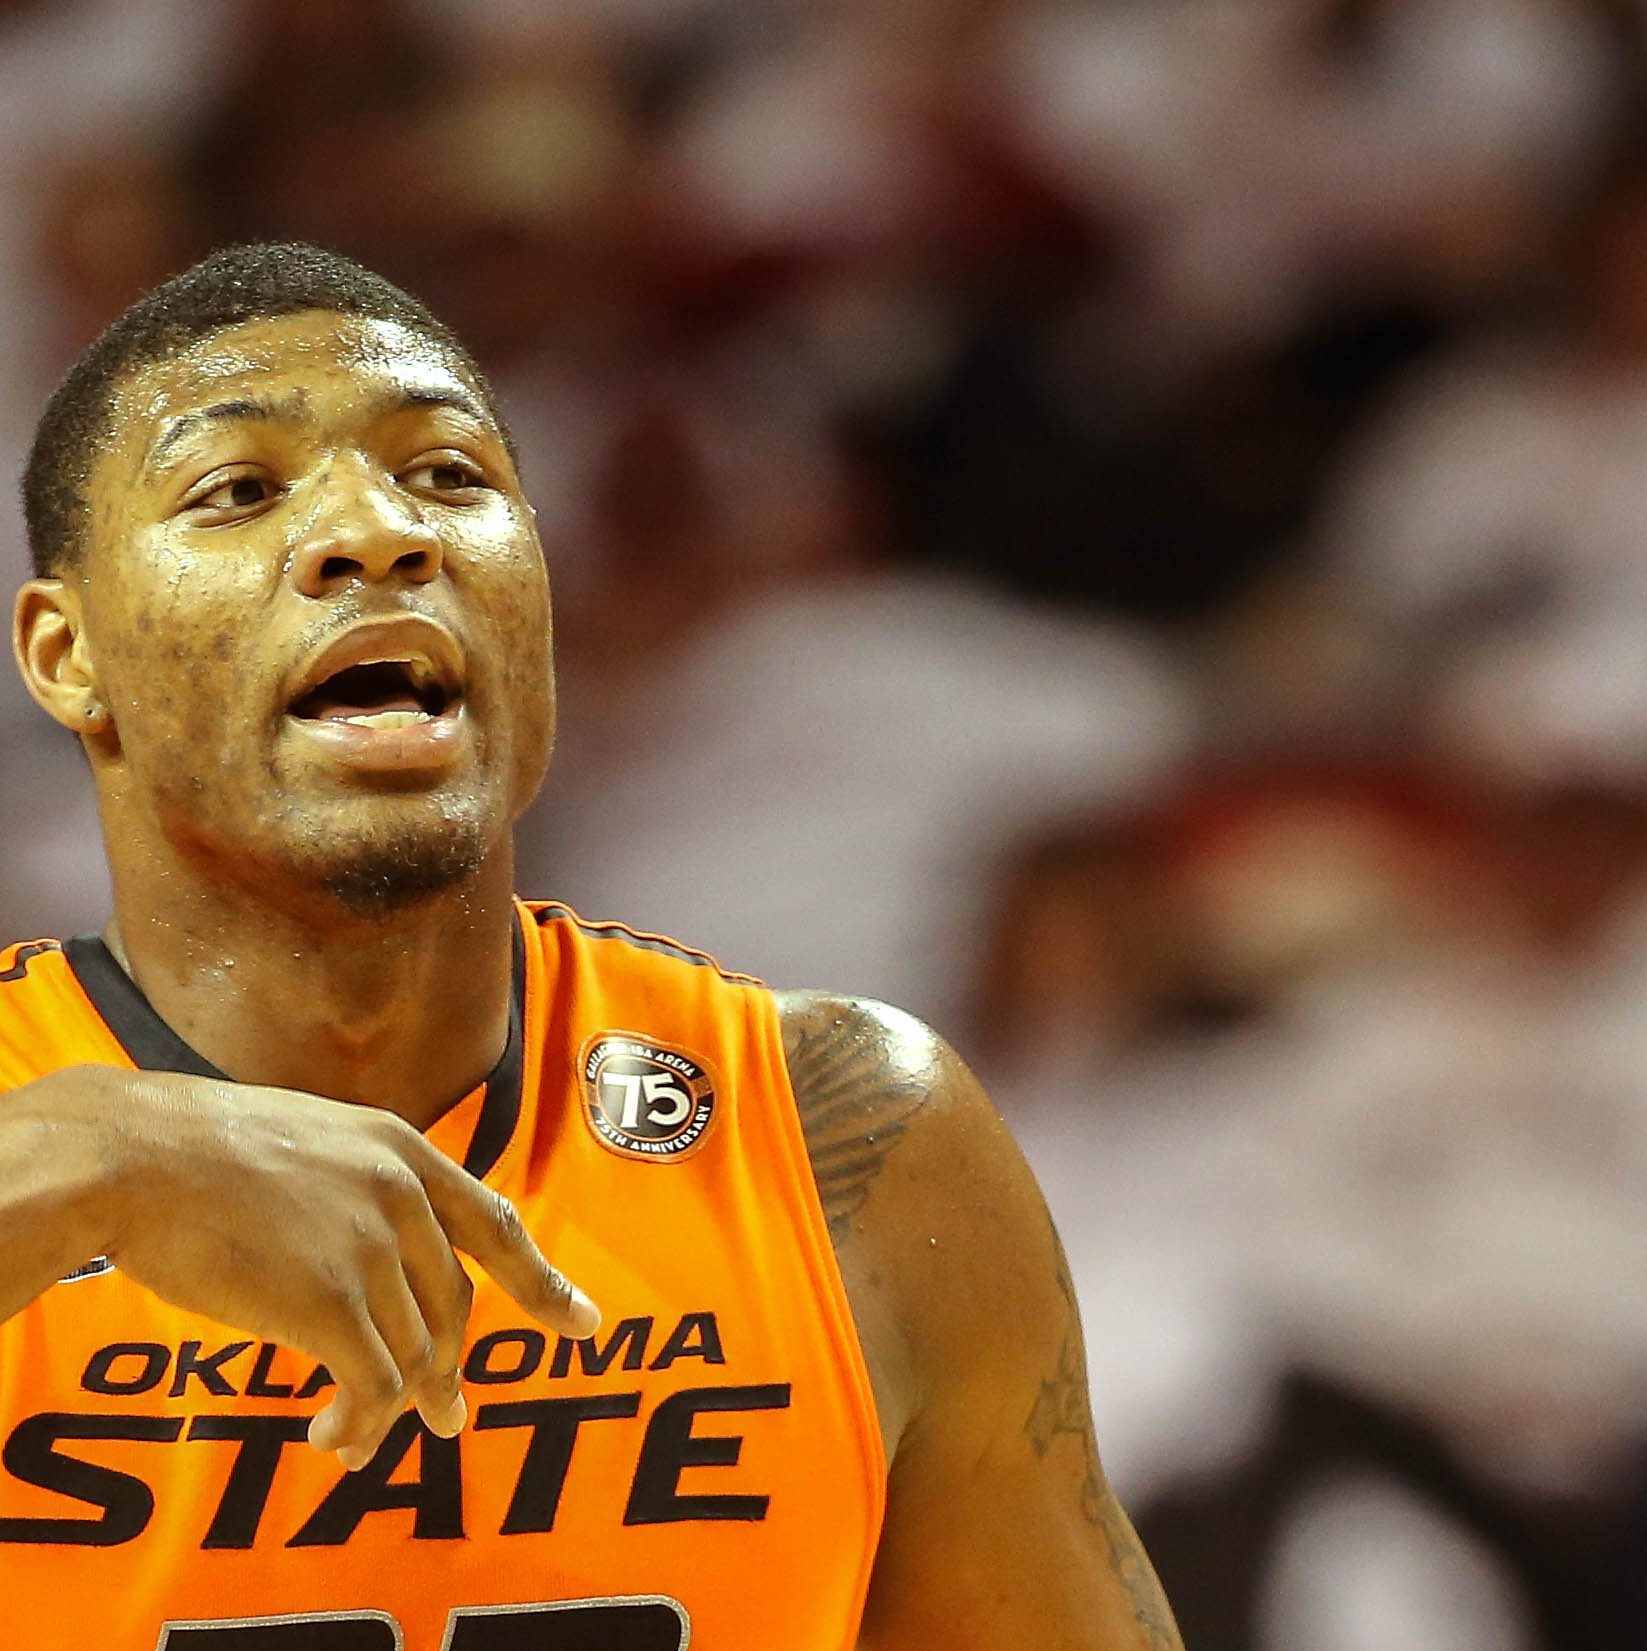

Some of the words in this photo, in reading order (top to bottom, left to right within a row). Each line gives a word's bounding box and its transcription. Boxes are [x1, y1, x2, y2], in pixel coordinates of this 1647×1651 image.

[655, 1052, 696, 1078] ARENA
[602, 1072, 691, 1129] 75
[595, 1117, 627, 1146] 75TH
[629, 1105, 712, 1153] ANNIVERSARY
[79, 1311, 726, 1398] OKLOMA
